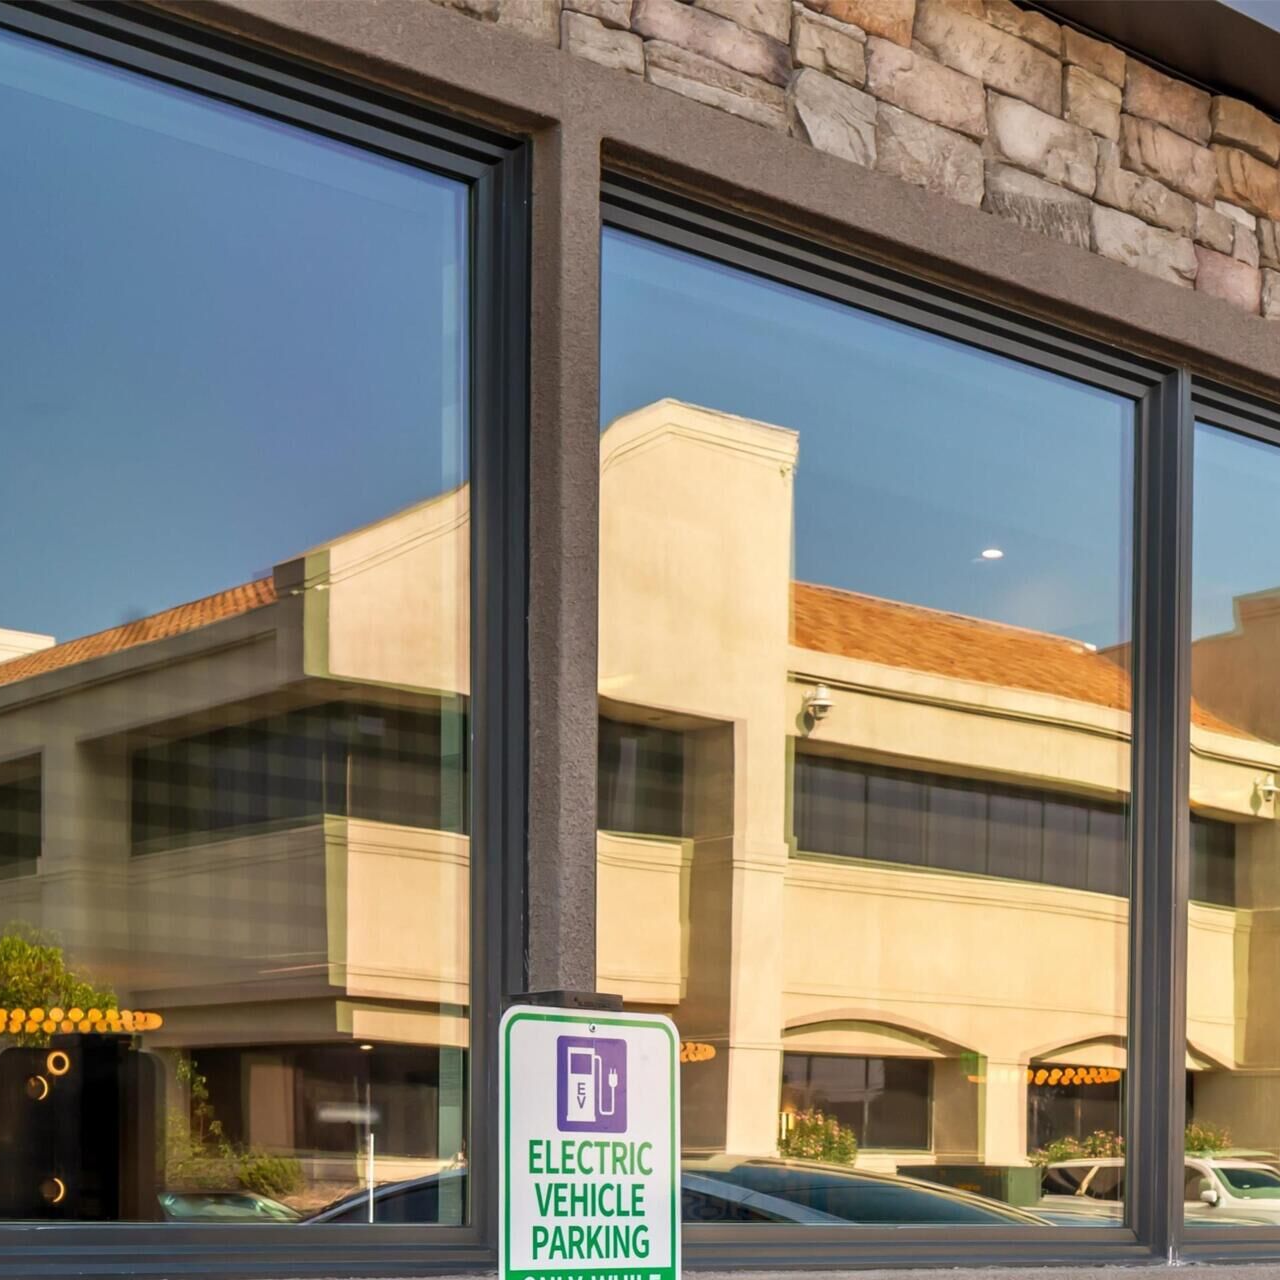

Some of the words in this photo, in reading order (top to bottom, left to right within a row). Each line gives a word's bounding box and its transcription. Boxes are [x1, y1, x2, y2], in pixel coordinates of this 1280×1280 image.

[576, 1082, 587, 1109] EV
[528, 1139, 653, 1176] ELECTRIC
[534, 1182, 646, 1218] VEHICLE
[532, 1224, 650, 1261] PARKING
